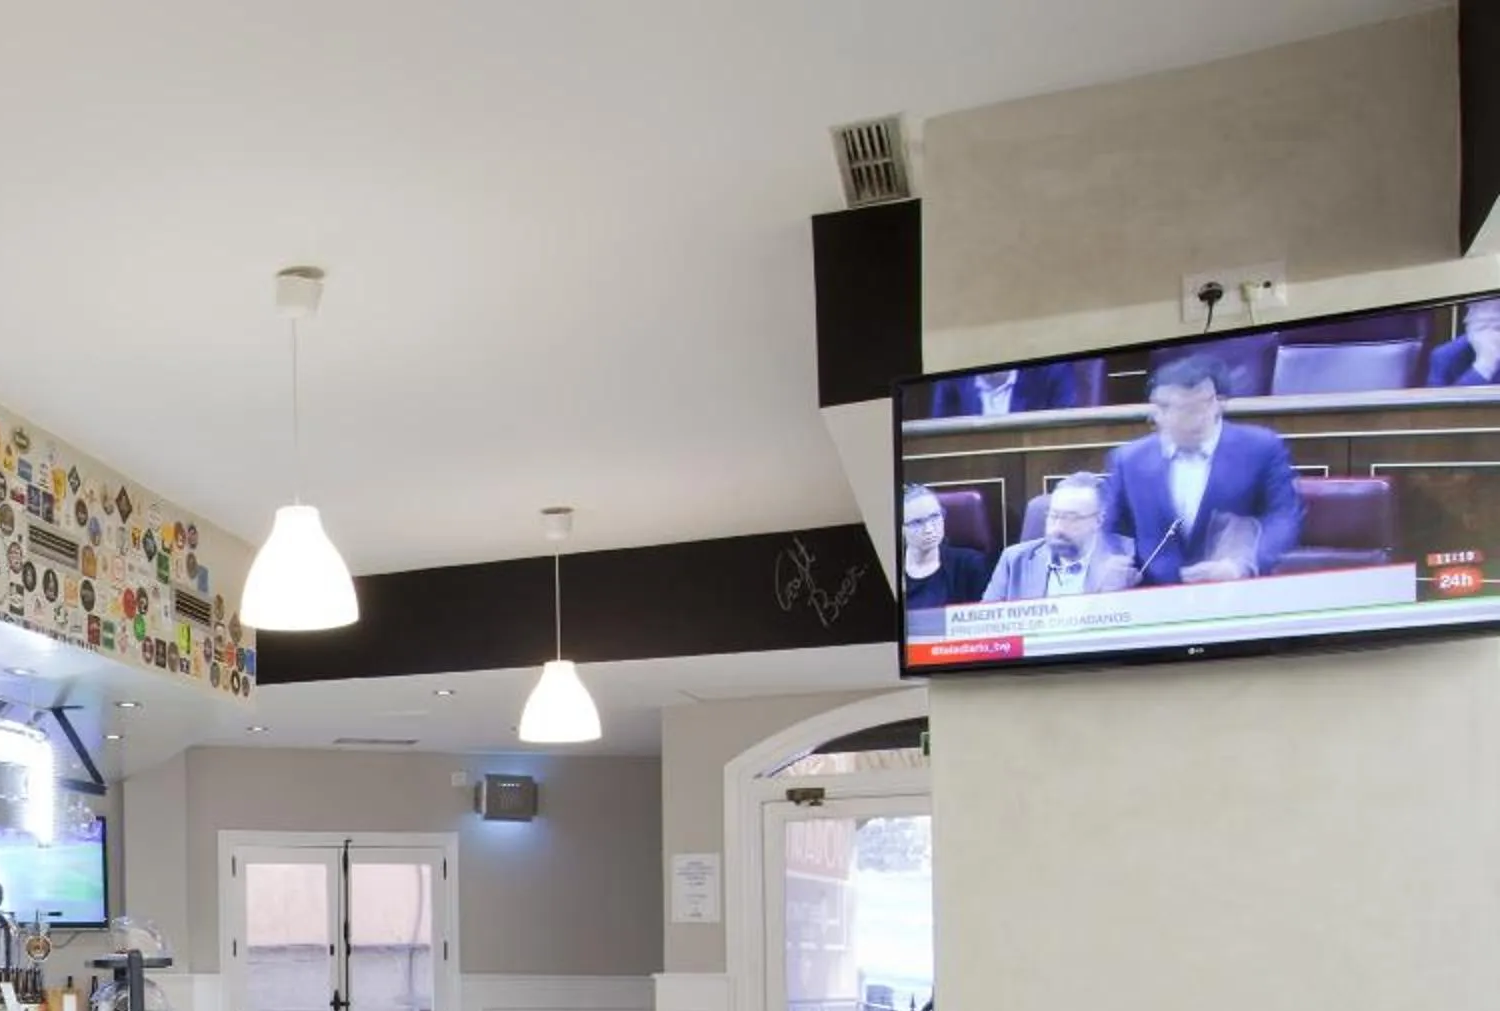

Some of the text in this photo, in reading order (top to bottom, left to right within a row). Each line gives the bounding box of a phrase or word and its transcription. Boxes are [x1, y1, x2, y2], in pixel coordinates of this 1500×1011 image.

[1439, 572, 1474, 589] 24h
[950, 603, 1060, 624] ALBERT RIVERA
